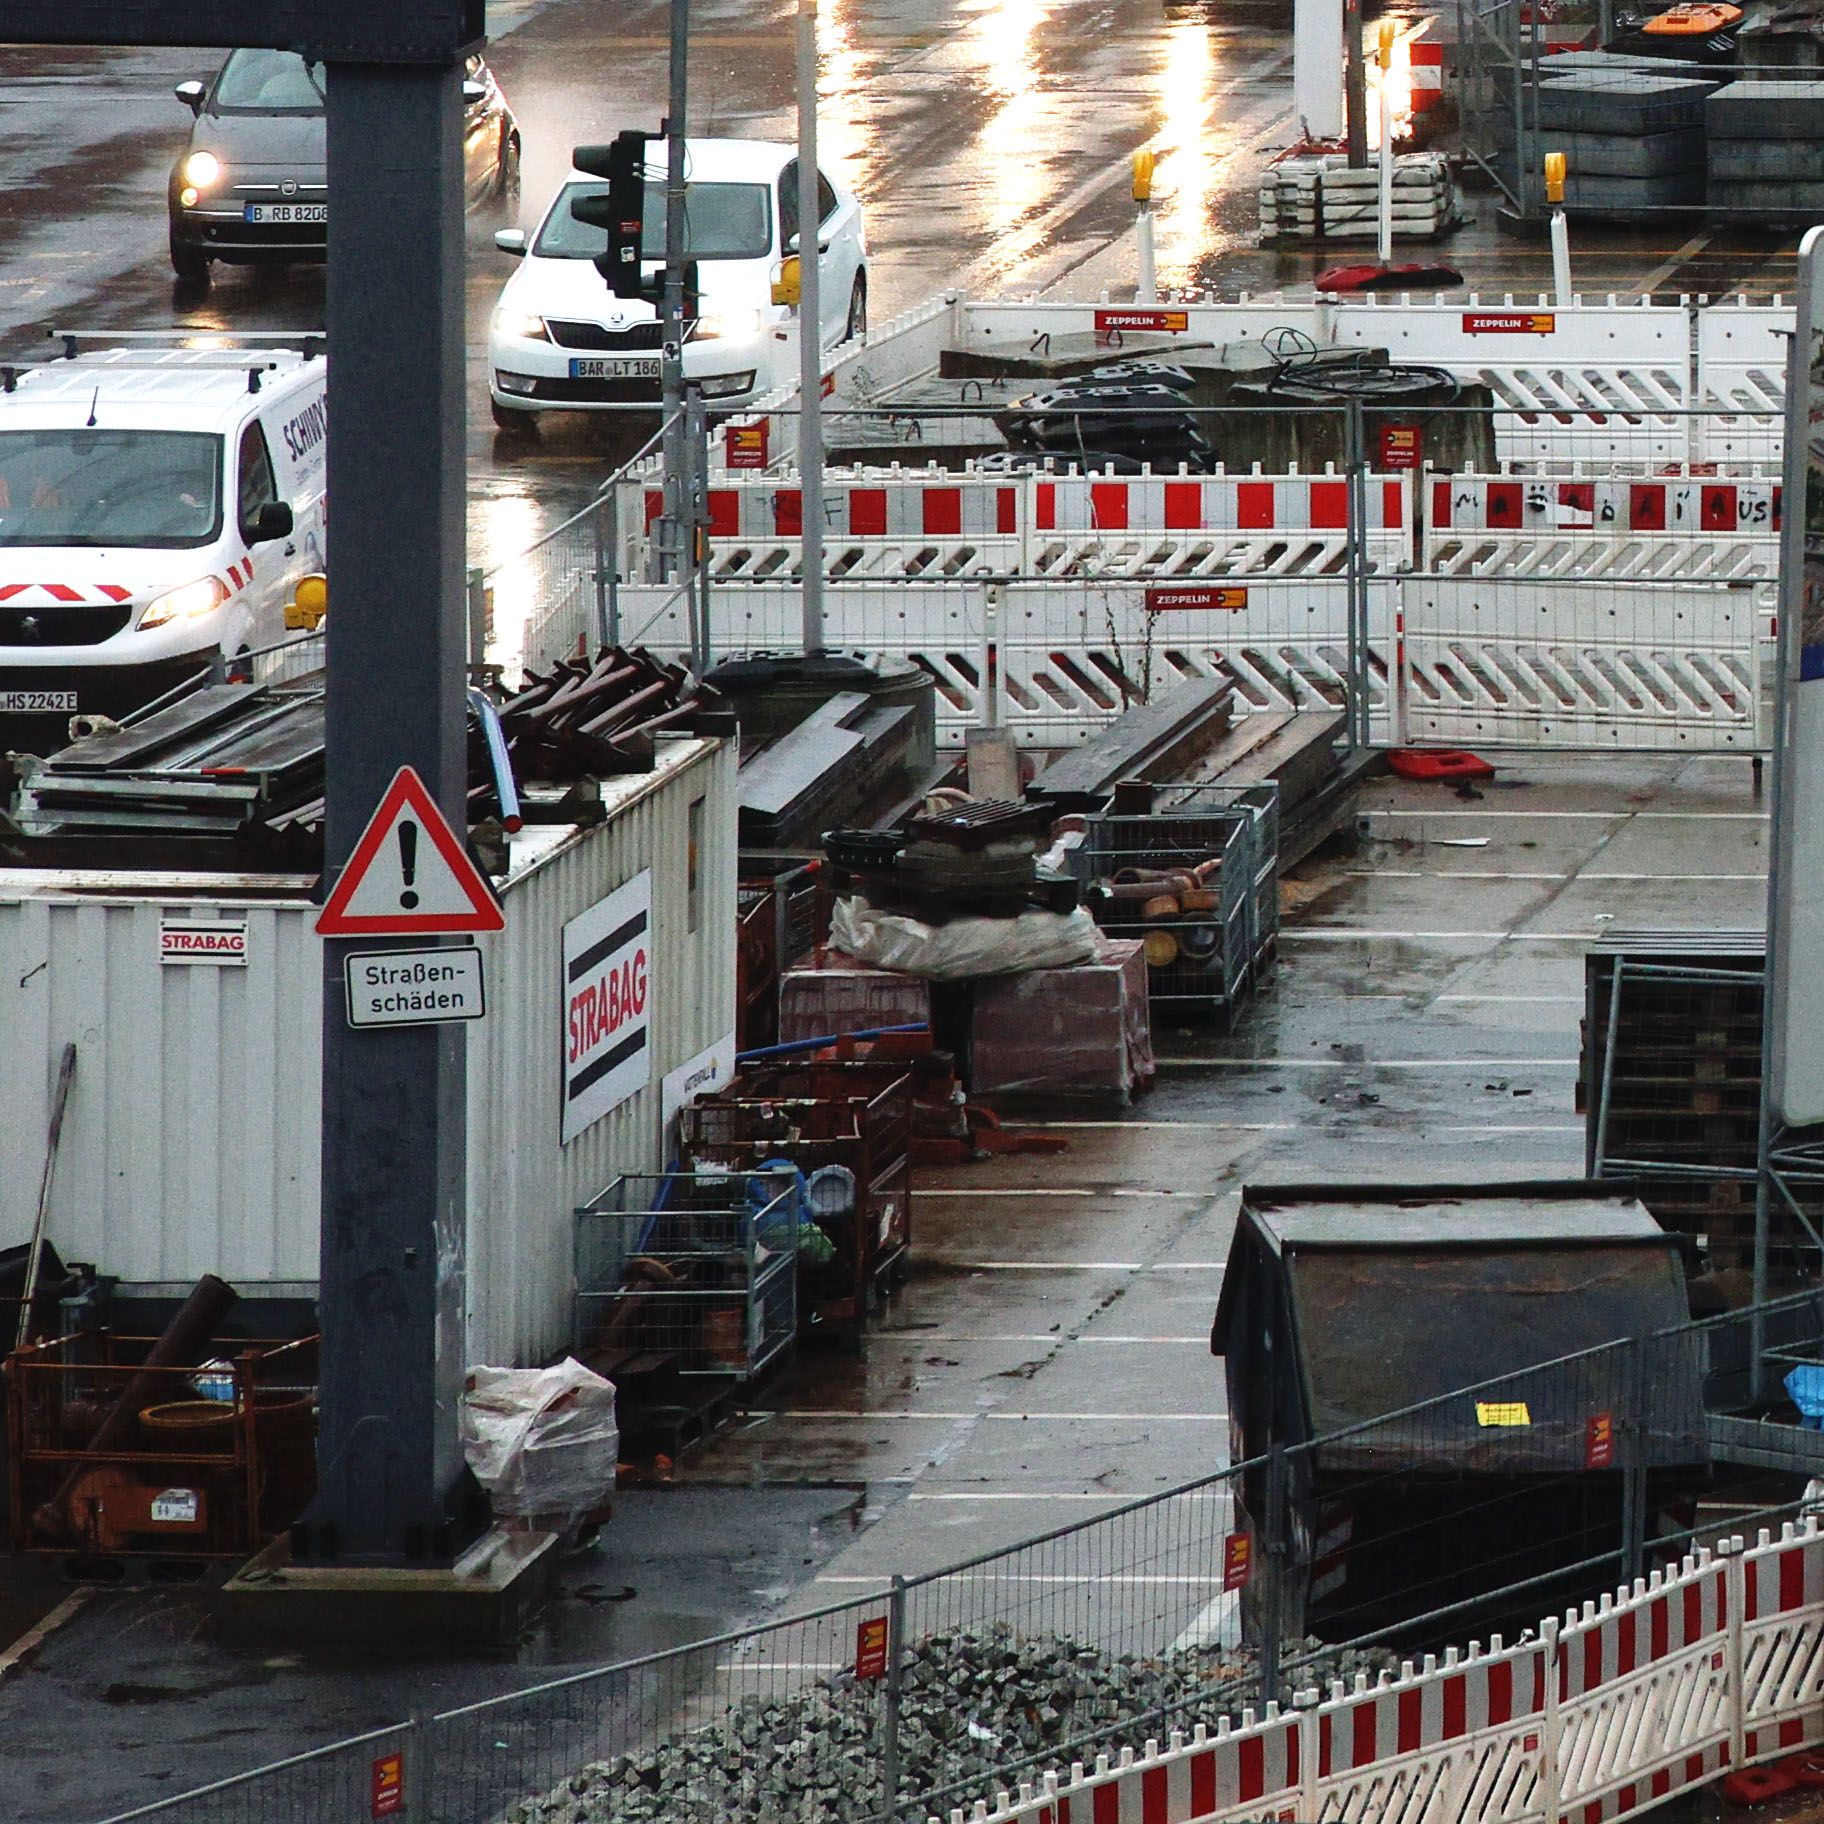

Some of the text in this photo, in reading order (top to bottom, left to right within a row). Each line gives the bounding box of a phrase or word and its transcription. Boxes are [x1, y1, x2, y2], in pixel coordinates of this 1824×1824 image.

[253, 207, 263, 223] B
[271, 207, 290, 223] RB
[1104, 315, 1153, 326] ZEPPELIN
[1472, 318, 1522, 328] ZEPPELIN
[578, 360, 660, 377] BAR LT 186
[1156, 594, 1211, 606] ZEPPELIN
[10, 693, 28, 711] HS
[161, 936, 245, 950] STRABAG
[366, 964, 468, 986] Straßen-
[371, 991, 466, 1013] schäden
[568, 947, 647, 1064] STRABAG
